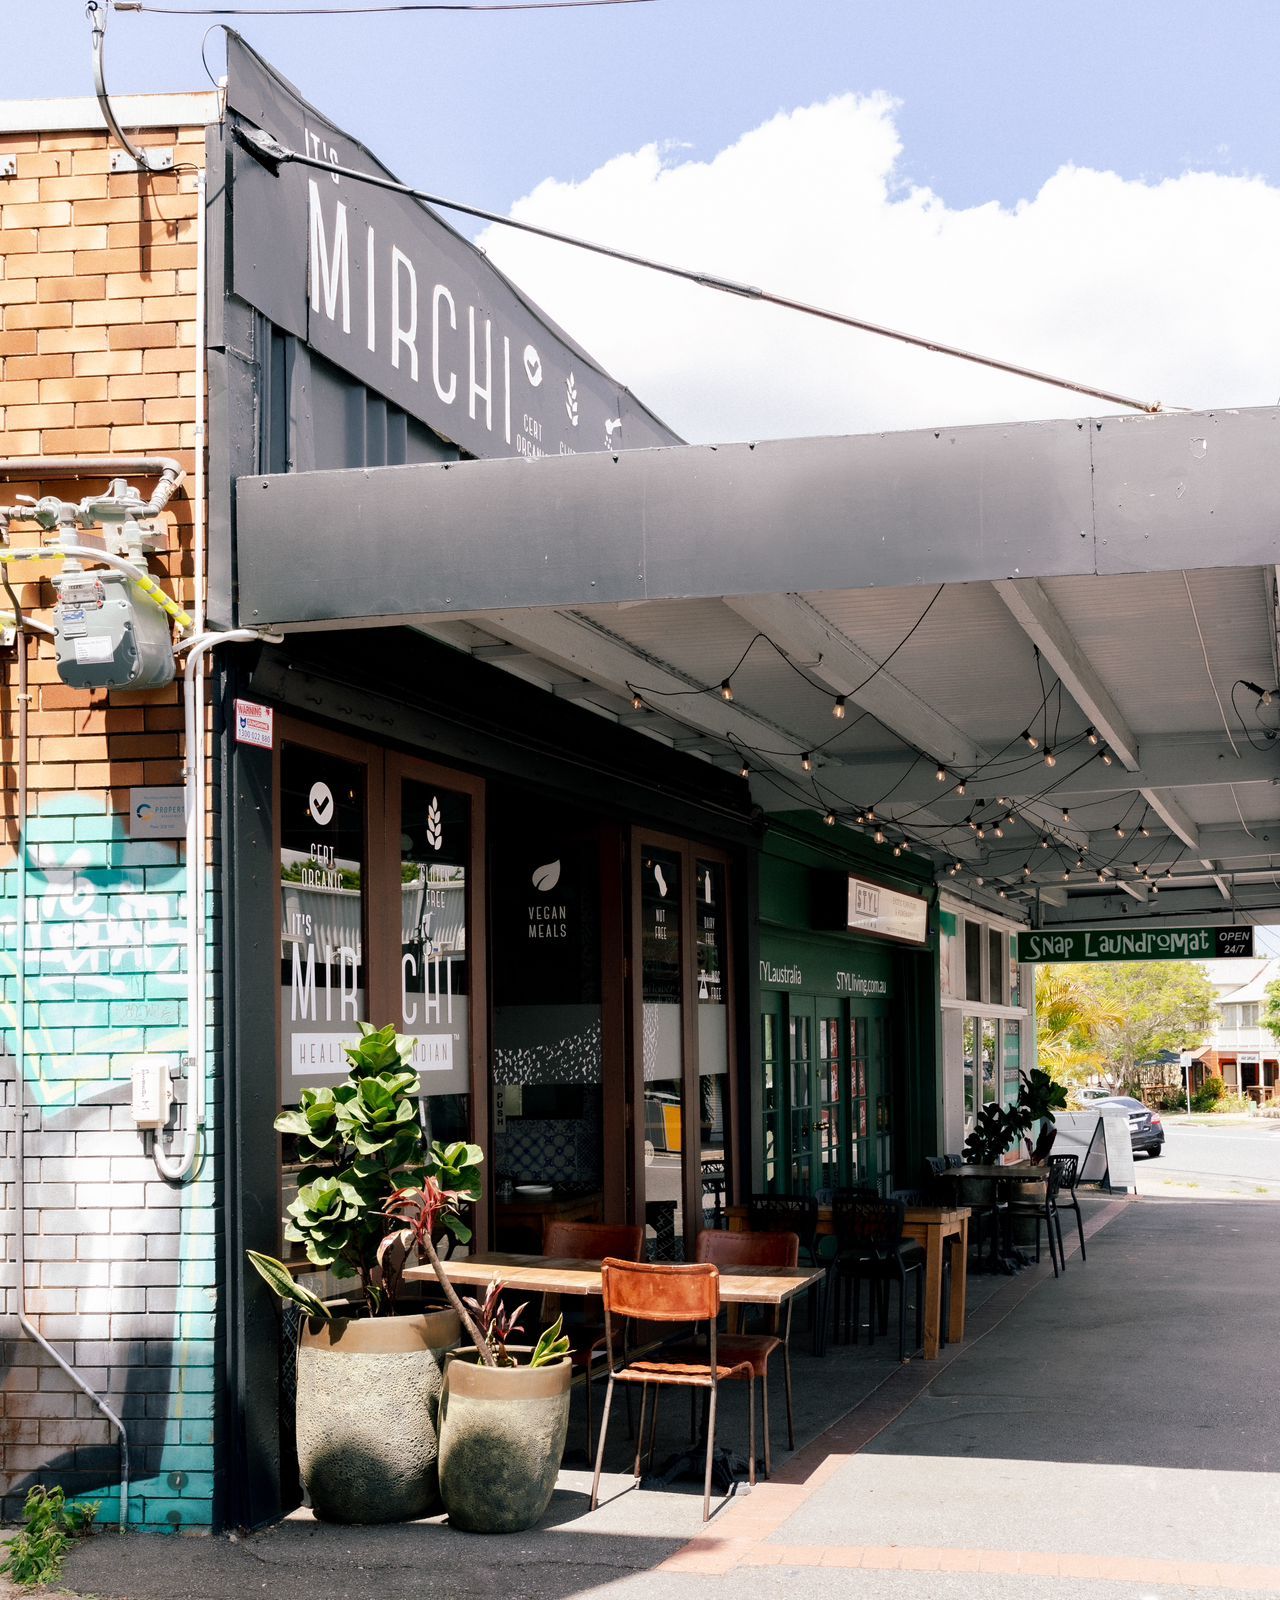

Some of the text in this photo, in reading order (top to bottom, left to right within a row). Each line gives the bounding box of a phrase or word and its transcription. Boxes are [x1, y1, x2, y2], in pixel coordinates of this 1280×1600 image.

[305, 128, 340, 184] IT'S
[308, 178, 511, 445] MIRCHI
[523, 414, 543, 443] CERT
[516, 433, 551, 458] ORGAN
[310, 842, 334, 866] CERT
[301, 867, 344, 892] ORGANIC
[426, 890, 446, 909] FREE
[528, 905, 567, 920] VEGAN
[655, 909, 666, 922] NUT
[292, 912, 312, 937] IT'S
[528, 923, 567, 938] MEALS
[655, 926, 667, 940] FREE
[1219, 931, 1250, 941] OPEN
[705, 932, 715, 946] FREE
[1223, 944, 1246, 954] 24/7
[759, 960, 802, 985] TYLaustralia
[300, 1042, 448, 1064] HEALT NDIAN
[496, 1092, 504, 1126] PUSH
